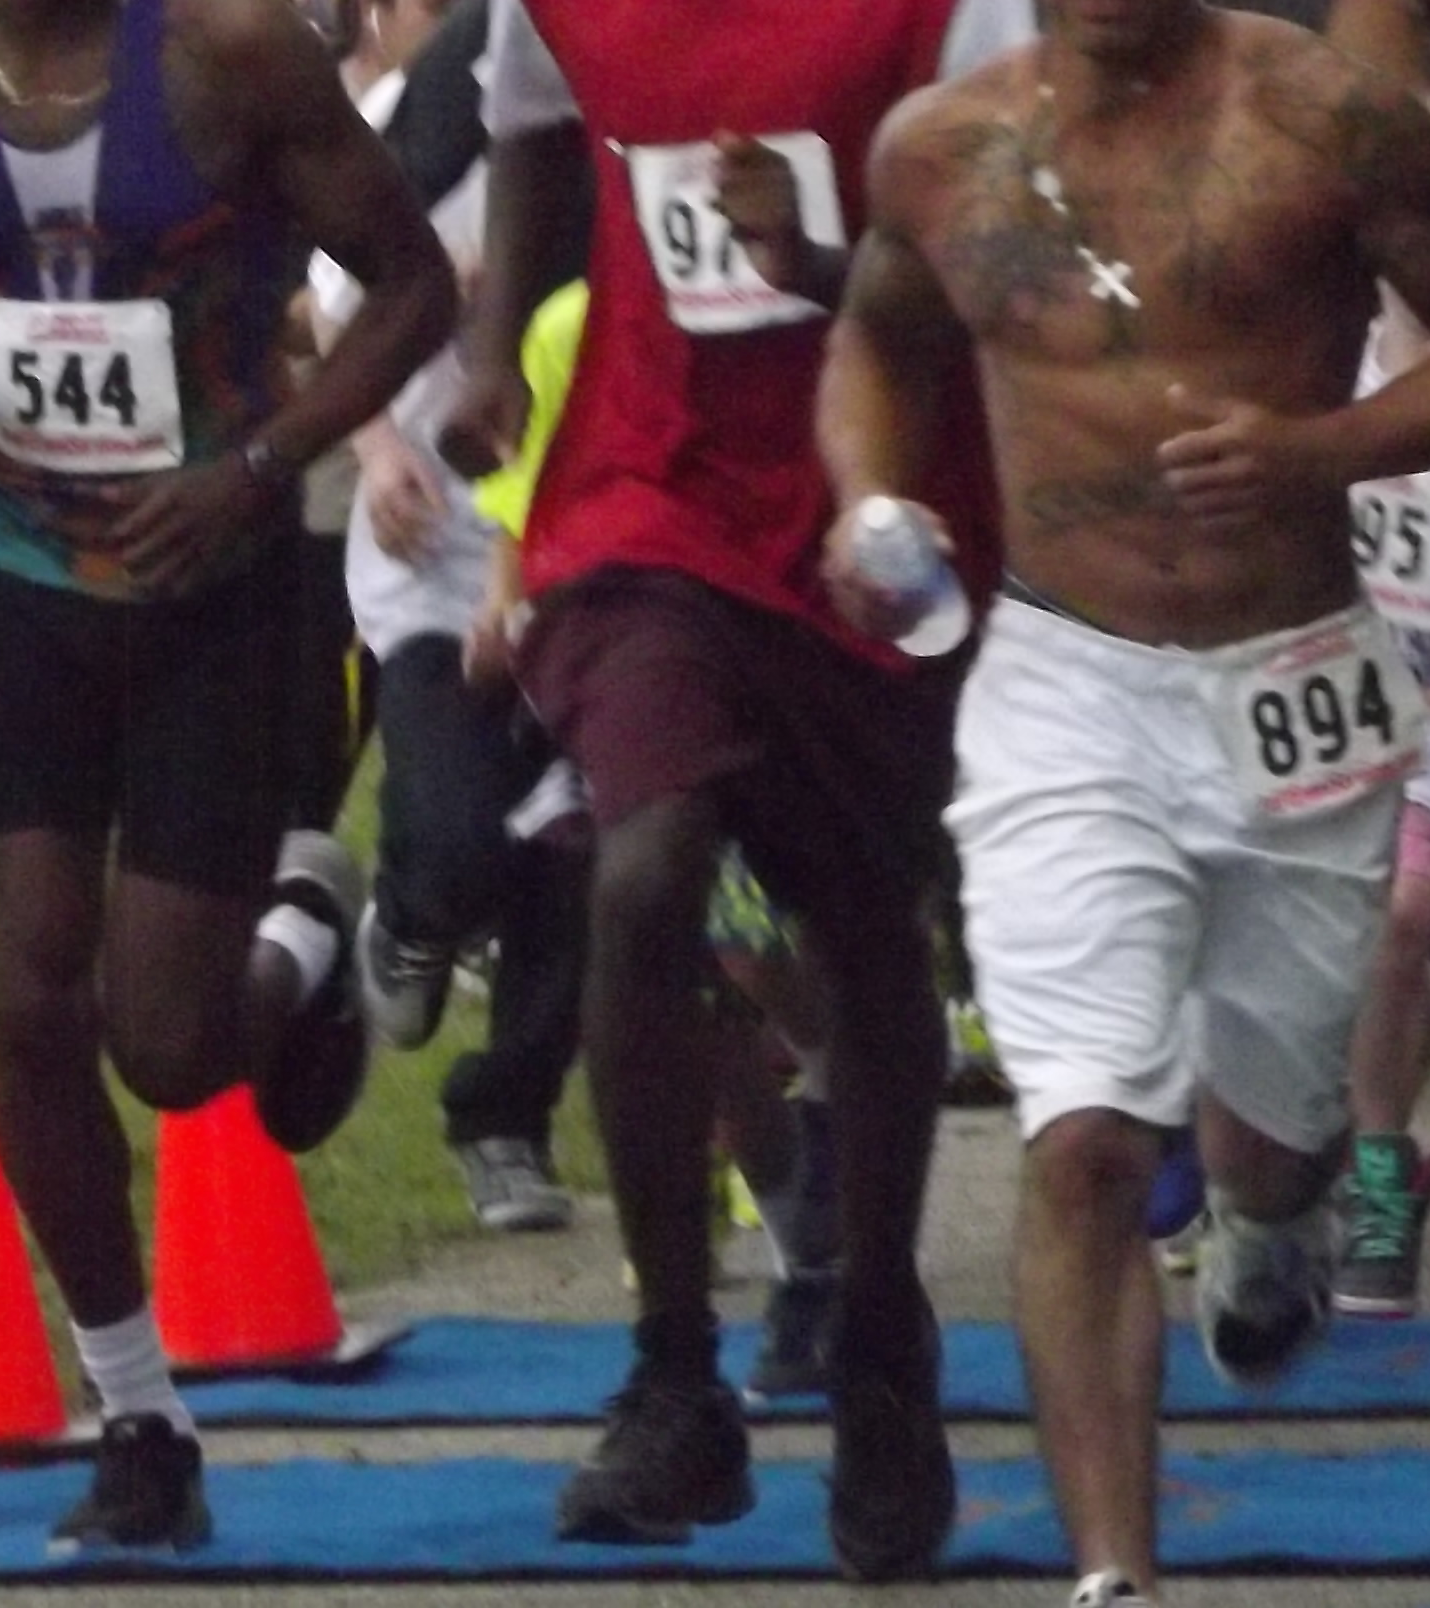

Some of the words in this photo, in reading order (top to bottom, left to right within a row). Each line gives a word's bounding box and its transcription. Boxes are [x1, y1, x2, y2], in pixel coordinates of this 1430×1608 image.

[10, 349, 138, 426] 544
[1351, 496, 1428, 578] 95
[1251, 658, 1395, 777] 894
